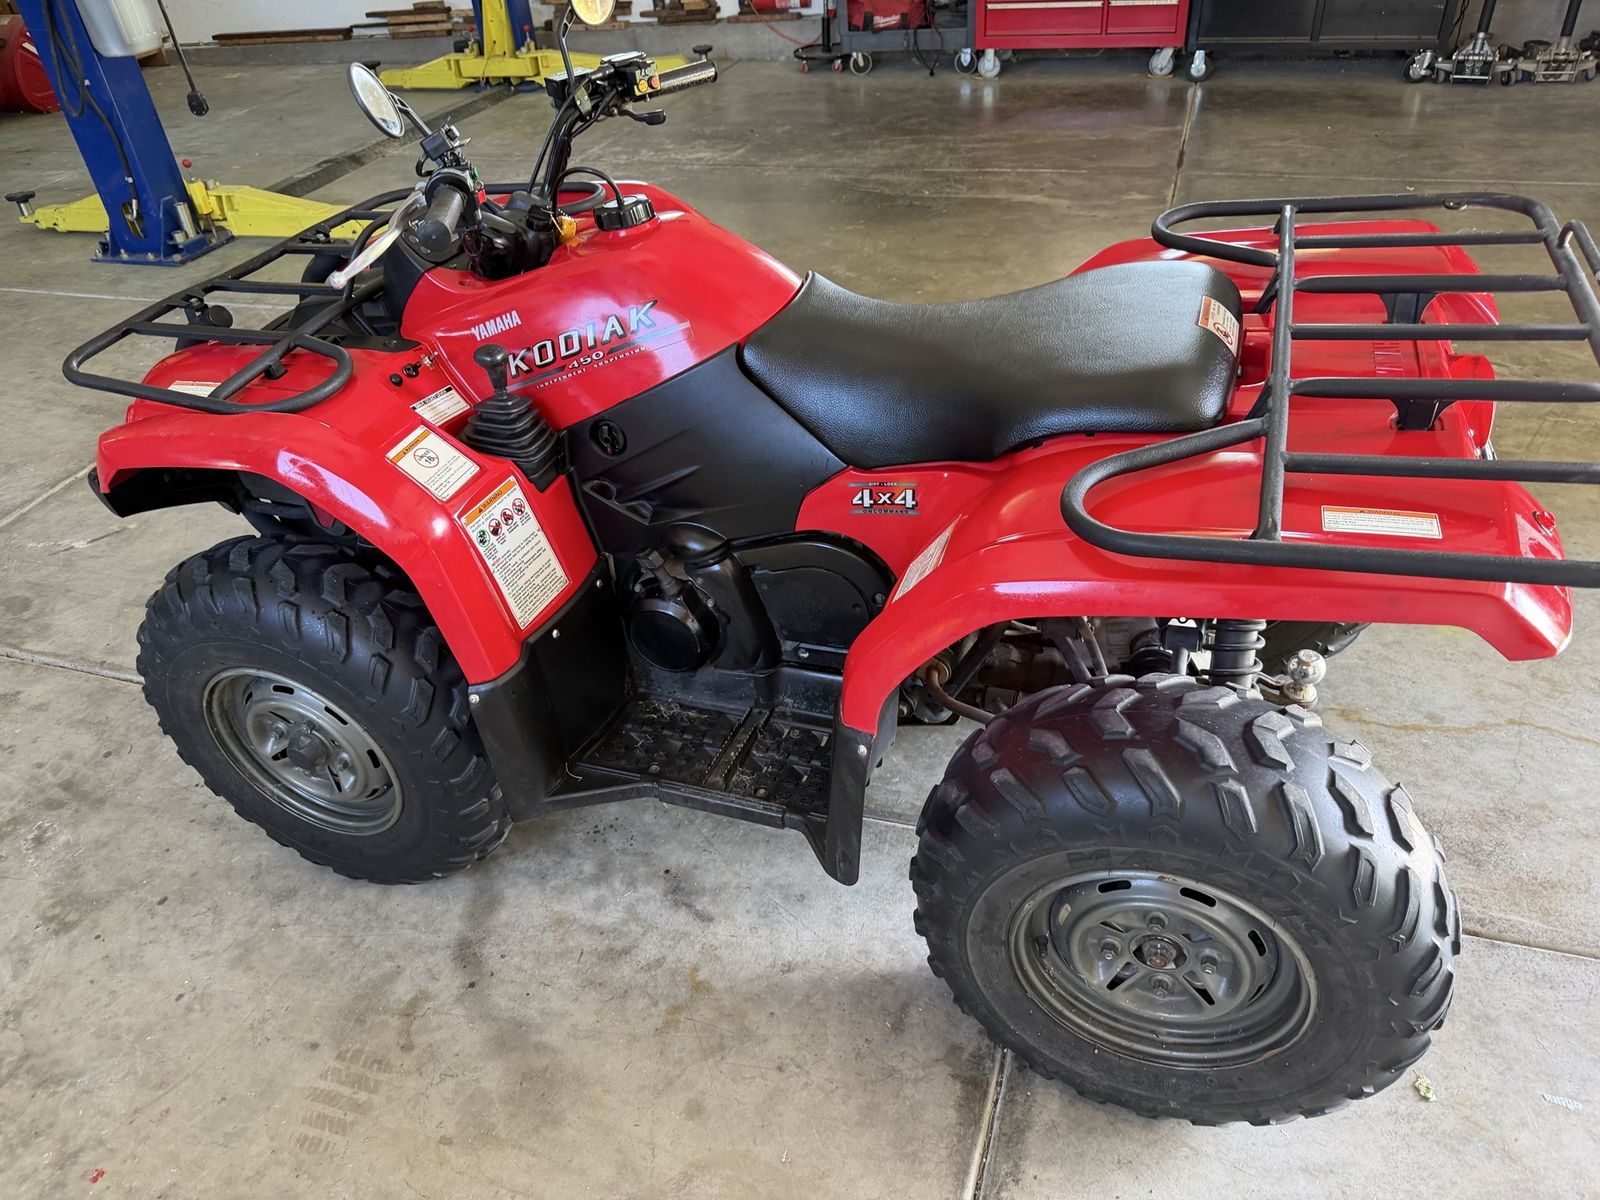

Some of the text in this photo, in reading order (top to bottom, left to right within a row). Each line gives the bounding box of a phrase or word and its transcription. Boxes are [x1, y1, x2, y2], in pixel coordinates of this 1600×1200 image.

[471, 310, 522, 342] YAMAHA
[507, 299, 658, 379] KODIAK
[536, 346, 648, 390] INDEPENDENT SUSPENSION
[567, 351, 606, 370] 450
[425, 454, 436, 464] 16
[482, 489, 502, 509] WARNING
[852, 488, 918, 510] 4x4
